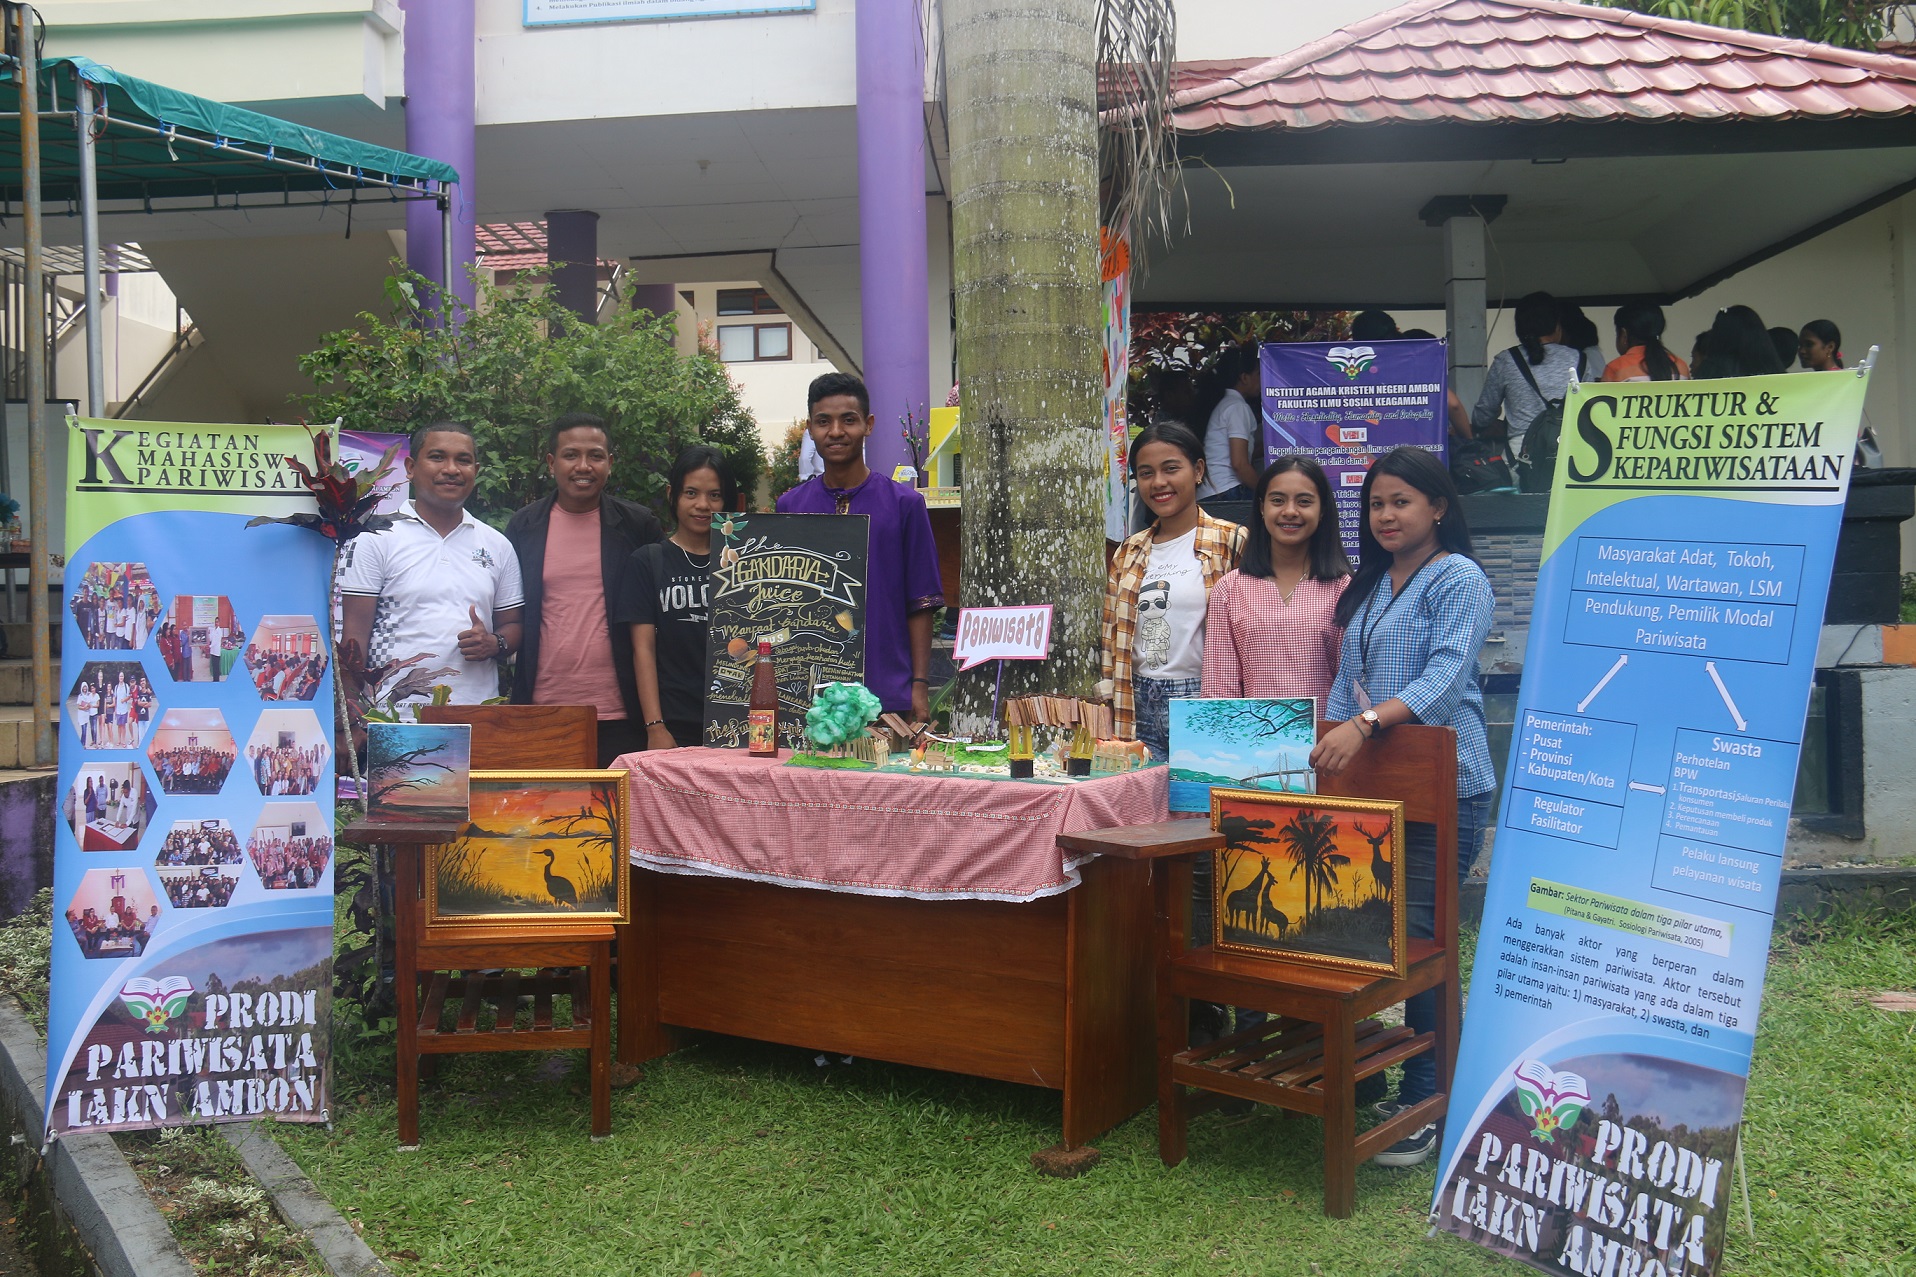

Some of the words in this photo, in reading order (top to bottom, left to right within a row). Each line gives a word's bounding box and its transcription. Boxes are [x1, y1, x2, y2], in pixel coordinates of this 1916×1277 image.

[1266, 387, 1305, 397] INSTITUT
[1306, 387, 1337, 397] AGAMA
[1338, 385, 1374, 395] KRISTEN
[1376, 384, 1407, 394] NEGERI
[1408, 383, 1440, 393] AMBON
[1277, 399, 1318, 409] FAKULTAS
[1320, 398, 1341, 408] ILMU
[1343, 397, 1374, 407] SOSIAL
[1375, 396, 1428, 406] KEAGAMAAN
[1755, 391, 1780, 416] &
[1616, 424, 1714, 450] FUNGSI
[1719, 421, 1824, 449] SISTEM
[1268, 446, 1292, 456] Unggul
[1293, 445, 1313, 454] dalam
[1315, 445, 1366, 456] pengembangan
[1328, 457, 1345, 465] cinta
[137, 466, 302, 488] PARIWISAT
[1612, 455, 1845, 481] KEPARIWISATAAN
[736, 556, 828, 583] GANDARIA
[1598, 545, 1676, 567] Masyarakat
[1679, 549, 1717, 569] Adat,
[1727, 550, 1775, 571] Tokoh,
[1586, 569, 1660, 592] Intelektual,
[1666, 575, 1743, 597] Wartawan,
[1749, 579, 1783, 597] LSM
[748, 583, 803, 613] Juice
[1585, 598, 1663, 622] Pendukung,
[1668, 604, 1720, 623] Pemilik
[1724, 608, 1774, 628] Modal
[1635, 628, 1707, 650] Pariwisata
[1526, 715, 1593, 736] Pemerintah:
[1533, 733, 1563, 749] Pusat
[1712, 737, 1762, 758] Swasta
[1530, 748, 1573, 766] Provinsi
[1675, 752, 1730, 771] Perhotelan
[1527, 762, 1615, 788] Kabupaten/Kota
[1674, 766, 1698, 780] BPW
[1533, 796, 1585, 817] Regulator
[1679, 794, 1714, 807] konsumen
[1531, 813, 1583, 834] Fasilitator
[1674, 821, 1718, 837] Pemantauan
[1675, 812, 1720, 827] Perencanaan
[1677, 804, 1714, 817] Keputusan
[1714, 811, 1746, 823] membeli
[1746, 816, 1773, 828] produk
[1682, 846, 1715, 863] Pelaku
[1718, 852, 1760, 874] lansung
[1672, 864, 1725, 884] pelayanan
[1727, 876, 1762, 893] wisata
[1530, 882, 1564, 900] Gambar:
[1566, 892, 1590, 906] Sektor
[1590, 897, 1629, 915] Pariwisata
[1630, 907, 1655, 922] dalam
[1656, 913, 1673, 926] tiga
[1672, 918, 1693, 931] pilar
[1694, 924, 1723, 939] utama,
[1564, 905, 1585, 919] (Pitana
[1586, 911, 1591, 920] &
[1619, 919, 1648, 934] Sosiologi
[1648, 927, 1683, 943] Pariwisata,
[1684, 936, 1704, 949] 2005)
[1505, 916, 1523, 930] Ada
[1535, 923, 1566, 941] banyak
[1578, 936, 1603, 951] aktor
[1615, 946, 1638, 962] yang
[1652, 954, 1697, 976] berperan
[1712, 970, 1744, 989] dalam
[1503, 935, 1564, 959] menggerakkan
[1570, 952, 1599, 969] sistem
[1605, 962, 1656, 985] pariwisata.
[1663, 977, 1691, 994] Aktor
[1698, 986, 1741, 1008] tersebut
[1494, 983, 1504, 998] 3)
[1504, 987, 1553, 1011] pemerintah
[1500, 951, 1528, 967] adalah
[1531, 958, 1580, 982] insan-insan
[1583, 974, 1630, 996] pariwisata
[1634, 989, 1657, 1006] yang
[1660, 996, 1678, 1010] ada
[1683, 1002, 1714, 1021] dalam
[1718, 1012, 1738, 1028] tiga
[205, 990, 316, 1030] PRODI
[1497, 968, 1516, 979] pilar
[1518, 975, 1544, 990] utama
[1546, 983, 1570, 998] yaitu:
[1572, 988, 1582, 1003] 1)
[1584, 993, 1638, 1020] masyarakat,
[1640, 1008, 1650, 1023] 2)
[1652, 1013, 1687, 1035] swasta,
[1691, 1022, 1710, 1039] dan
[86, 1033, 316, 1081] PARIWISATA
[191, 1075, 316, 1117] AMBON
[1591, 1119, 1722, 1209] PRODI
[1474, 1132, 1705, 1266] PARIWISATA
